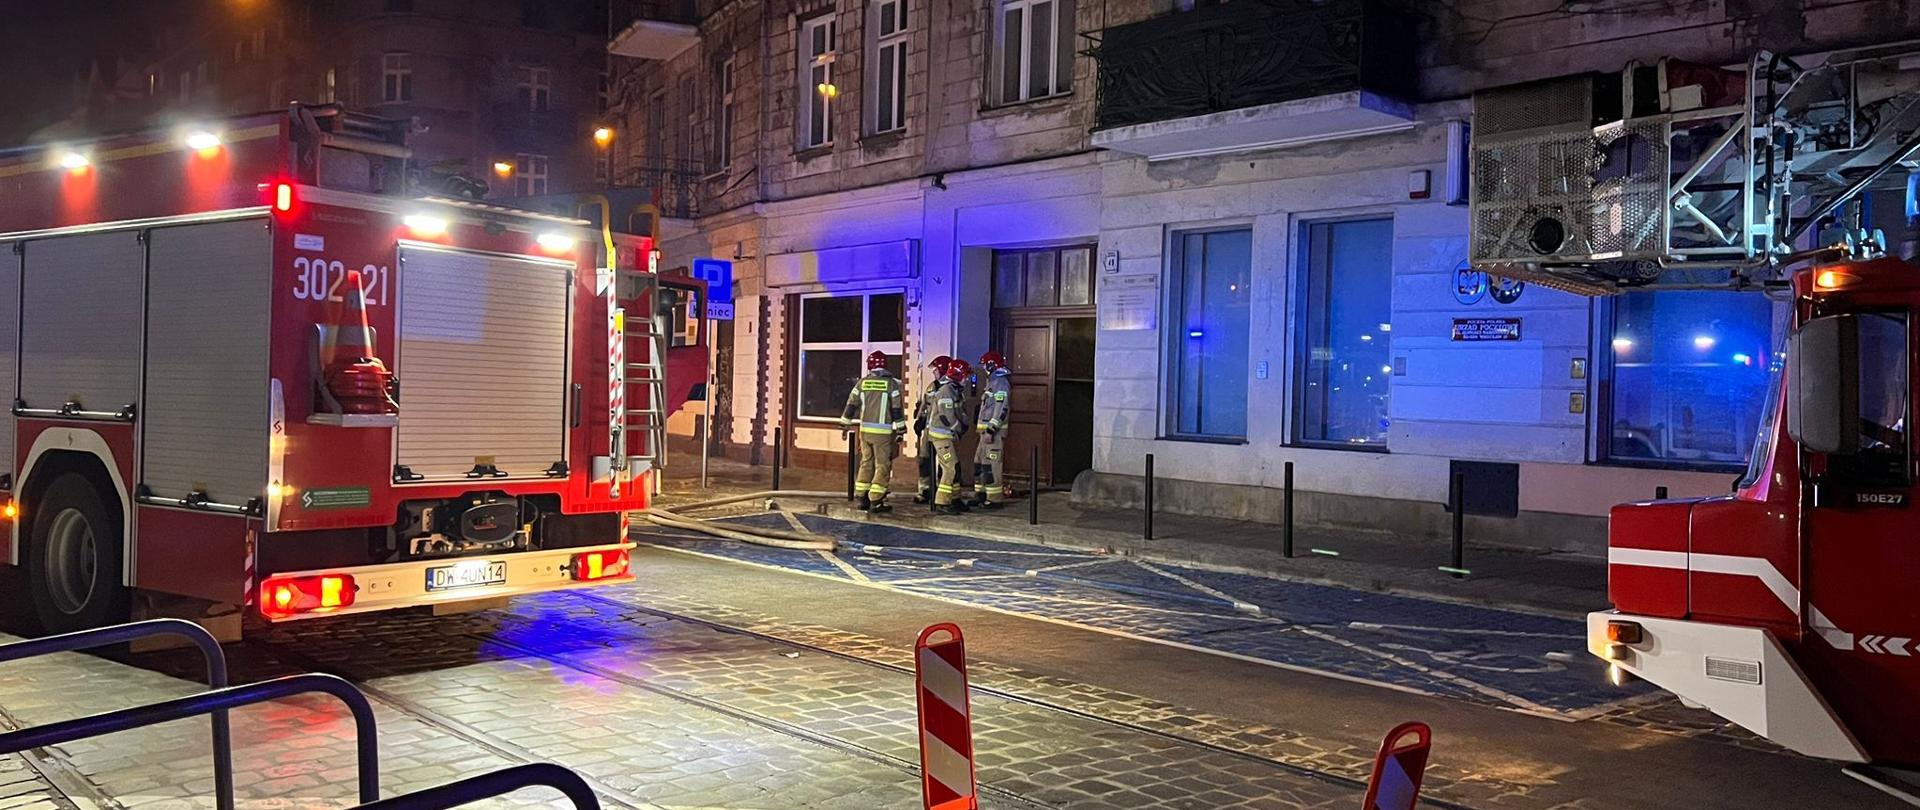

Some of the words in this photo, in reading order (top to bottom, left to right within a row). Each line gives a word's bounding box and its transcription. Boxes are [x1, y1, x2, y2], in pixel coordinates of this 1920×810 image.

[293, 256, 344, 302] 302
[363, 264, 388, 306] 21
[703, 264, 723, 287] P
[1856, 493, 1903, 504] 150E27
